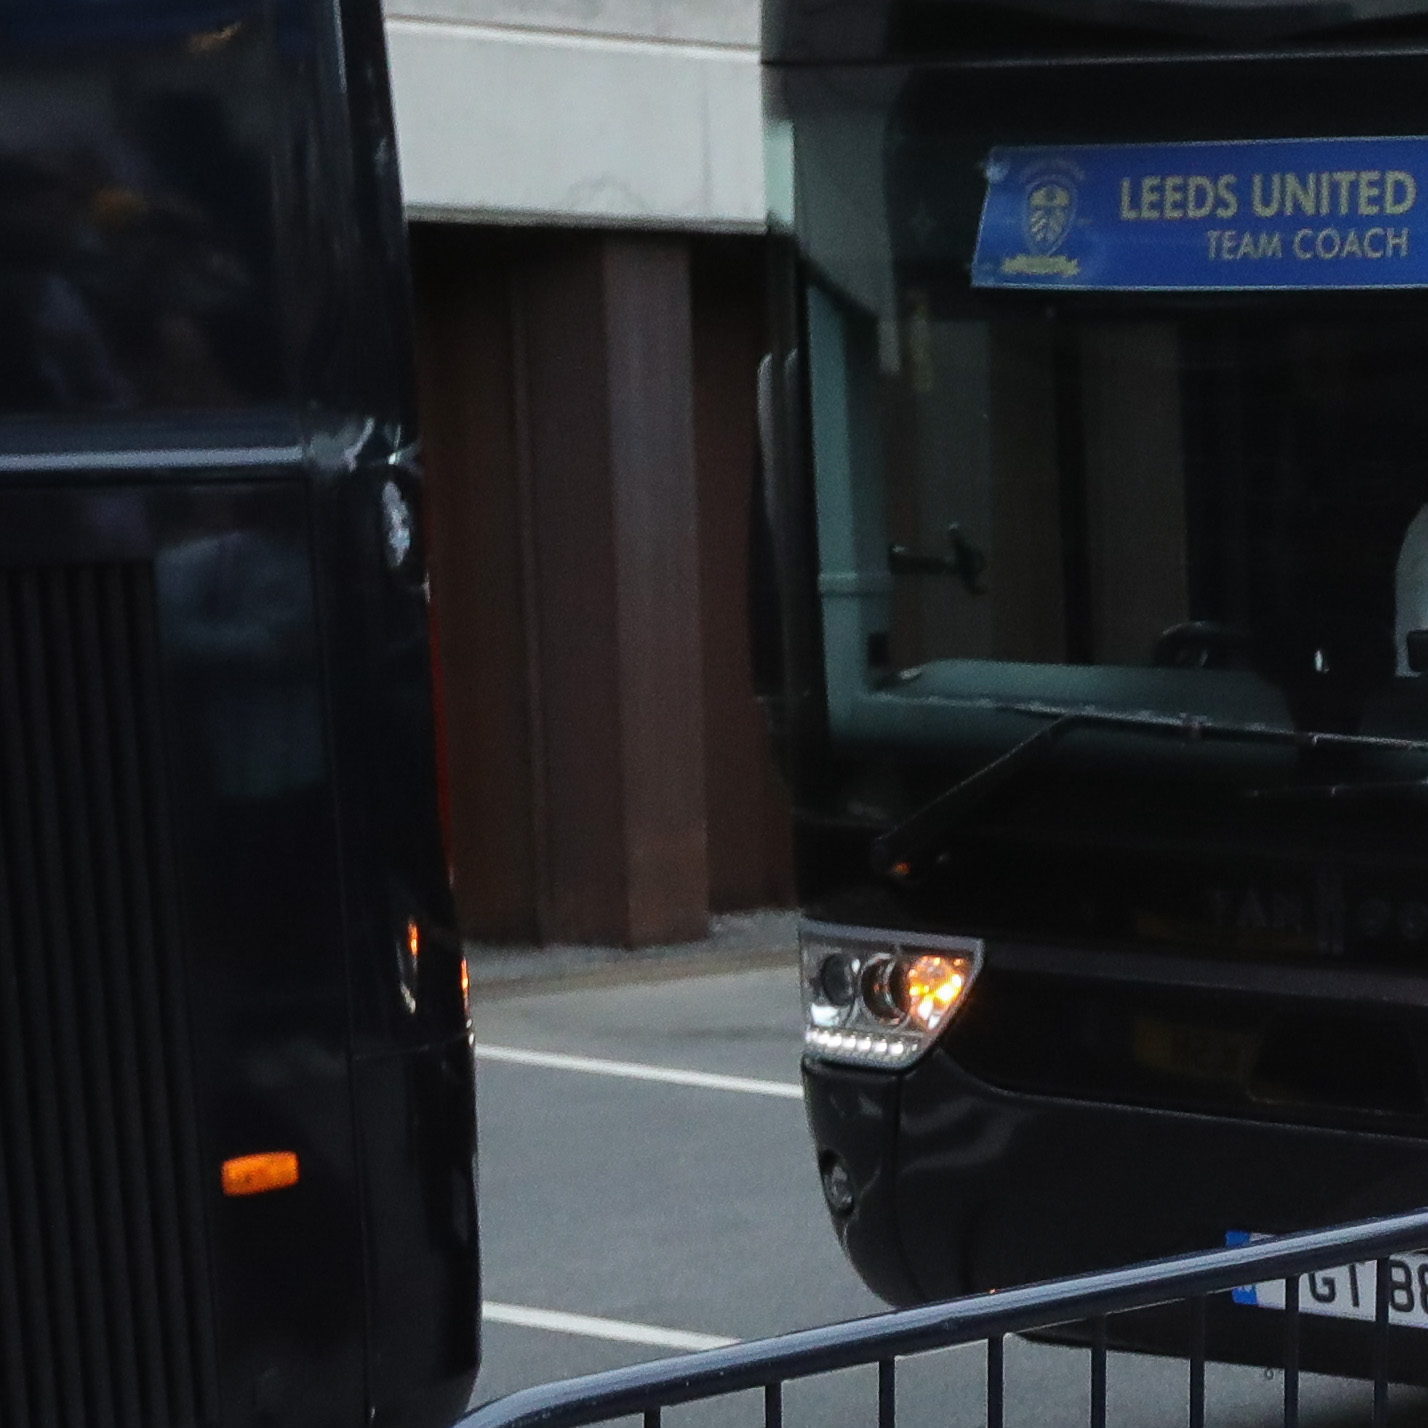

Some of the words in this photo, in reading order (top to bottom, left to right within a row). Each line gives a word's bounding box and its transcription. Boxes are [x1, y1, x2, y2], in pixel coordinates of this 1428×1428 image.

[1119, 173, 1238, 221] LEEDS
[1251, 169, 1417, 218] UNITED
[1207, 229, 1283, 260] TEAM
[1292, 226, 1410, 260] COACH
